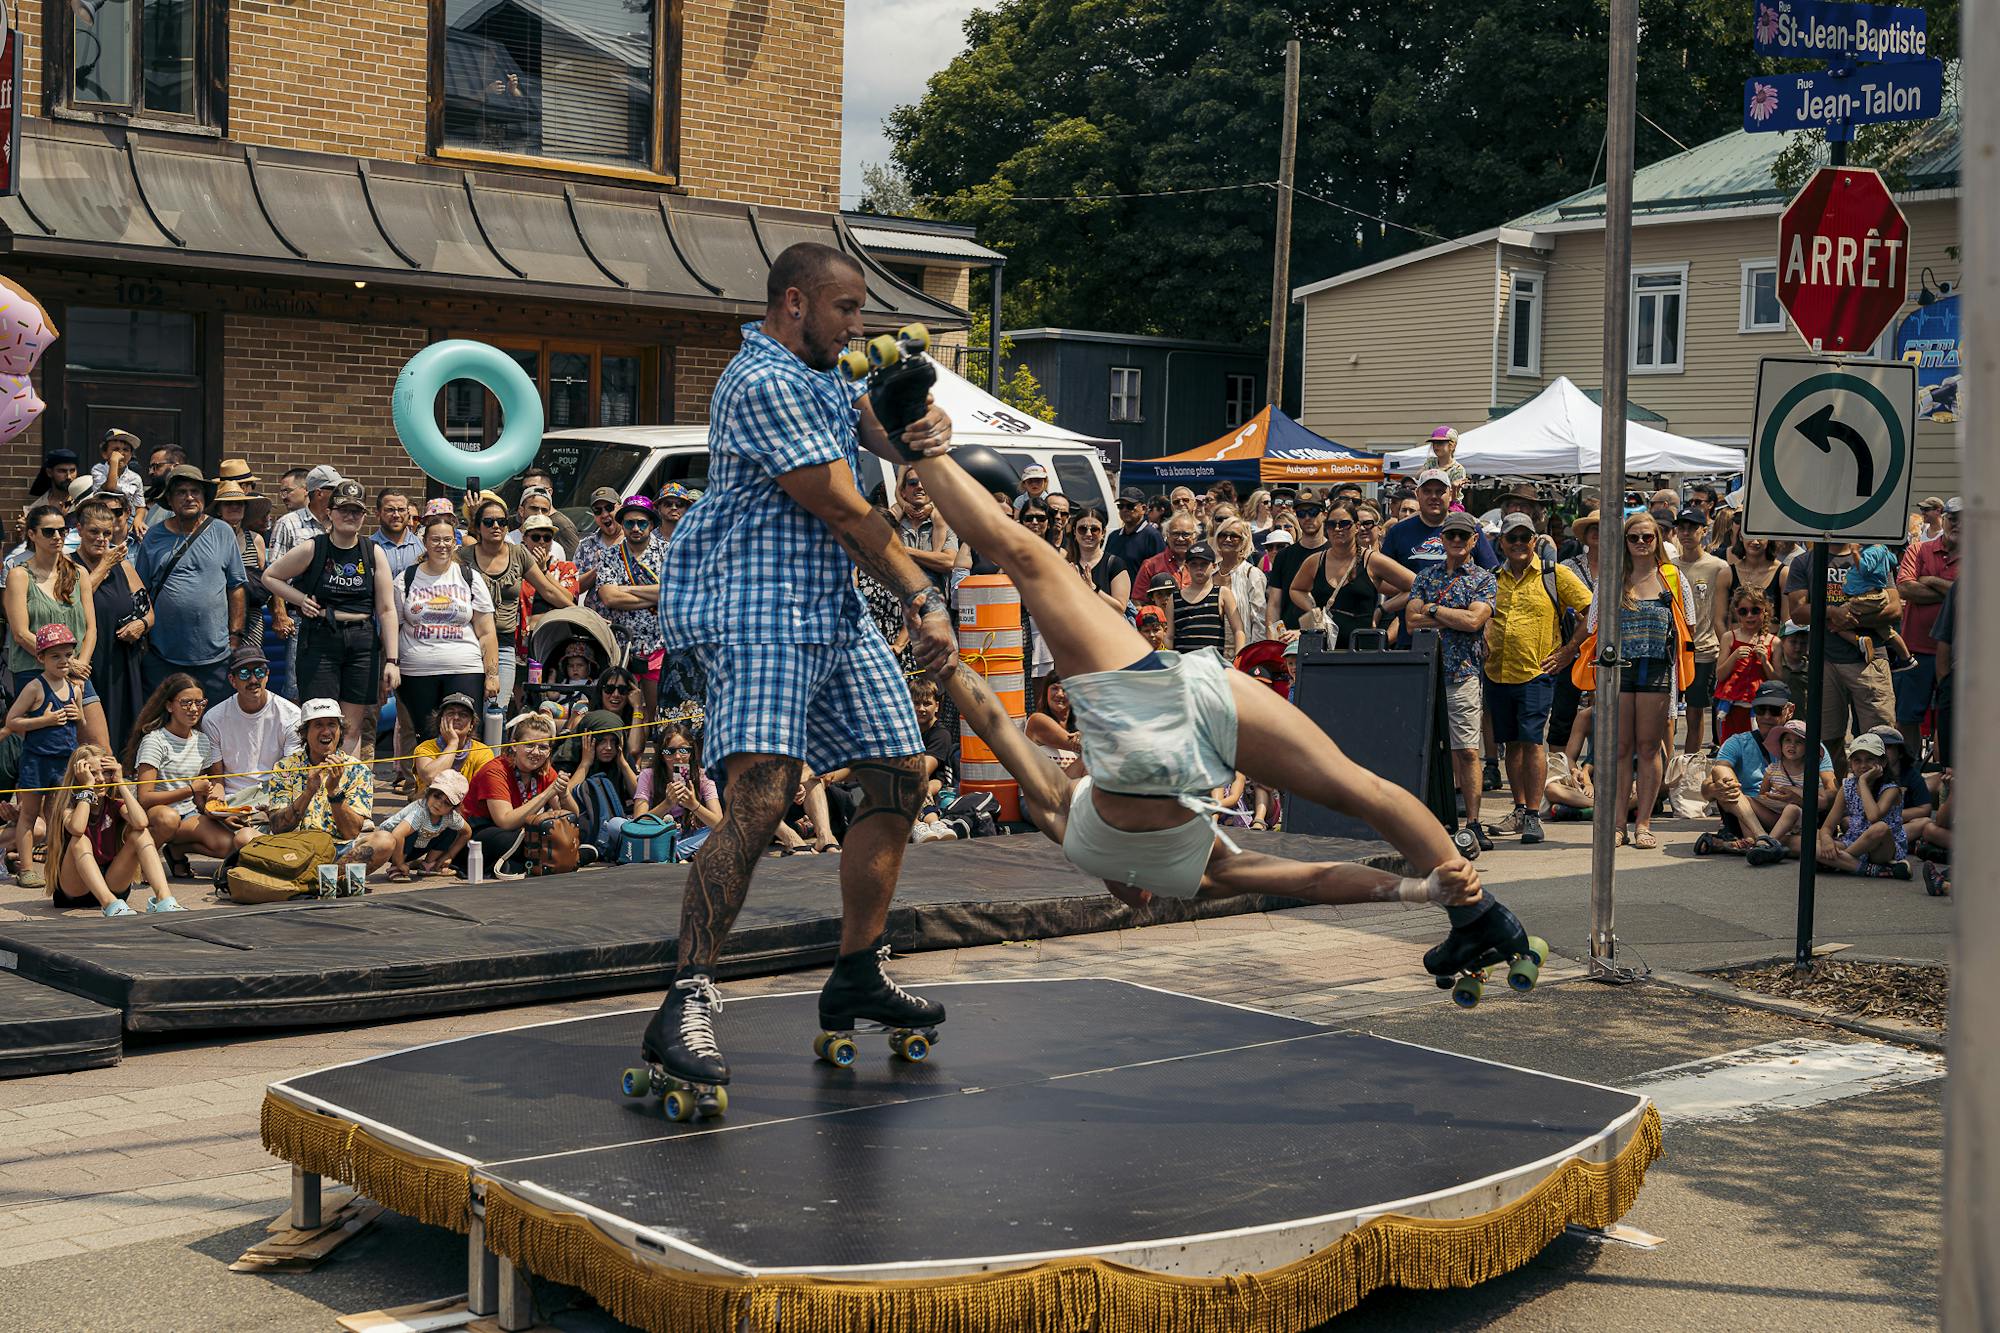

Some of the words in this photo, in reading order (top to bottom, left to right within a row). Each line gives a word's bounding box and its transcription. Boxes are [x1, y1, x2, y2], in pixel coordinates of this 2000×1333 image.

[1779, 1, 1791, 13] Rue
[1778, 14, 1926, 60] St-Jean-Baptiste
[1797, 78, 1814, 90] Rue
[1797, 82, 1921, 121] Jean-Talon
[1784, 228, 1903, 288] ARRÊT
[114, 282, 163, 305] 102
[244, 295, 317, 314] LOCATION
[559, 456, 577, 465] POUR
[1174, 466, 1195, 476] bonne
[1196, 466, 1214, 477] place
[1286, 465, 1318, 475] Auberge
[1331, 464, 1369, 474] Resto-Pub
